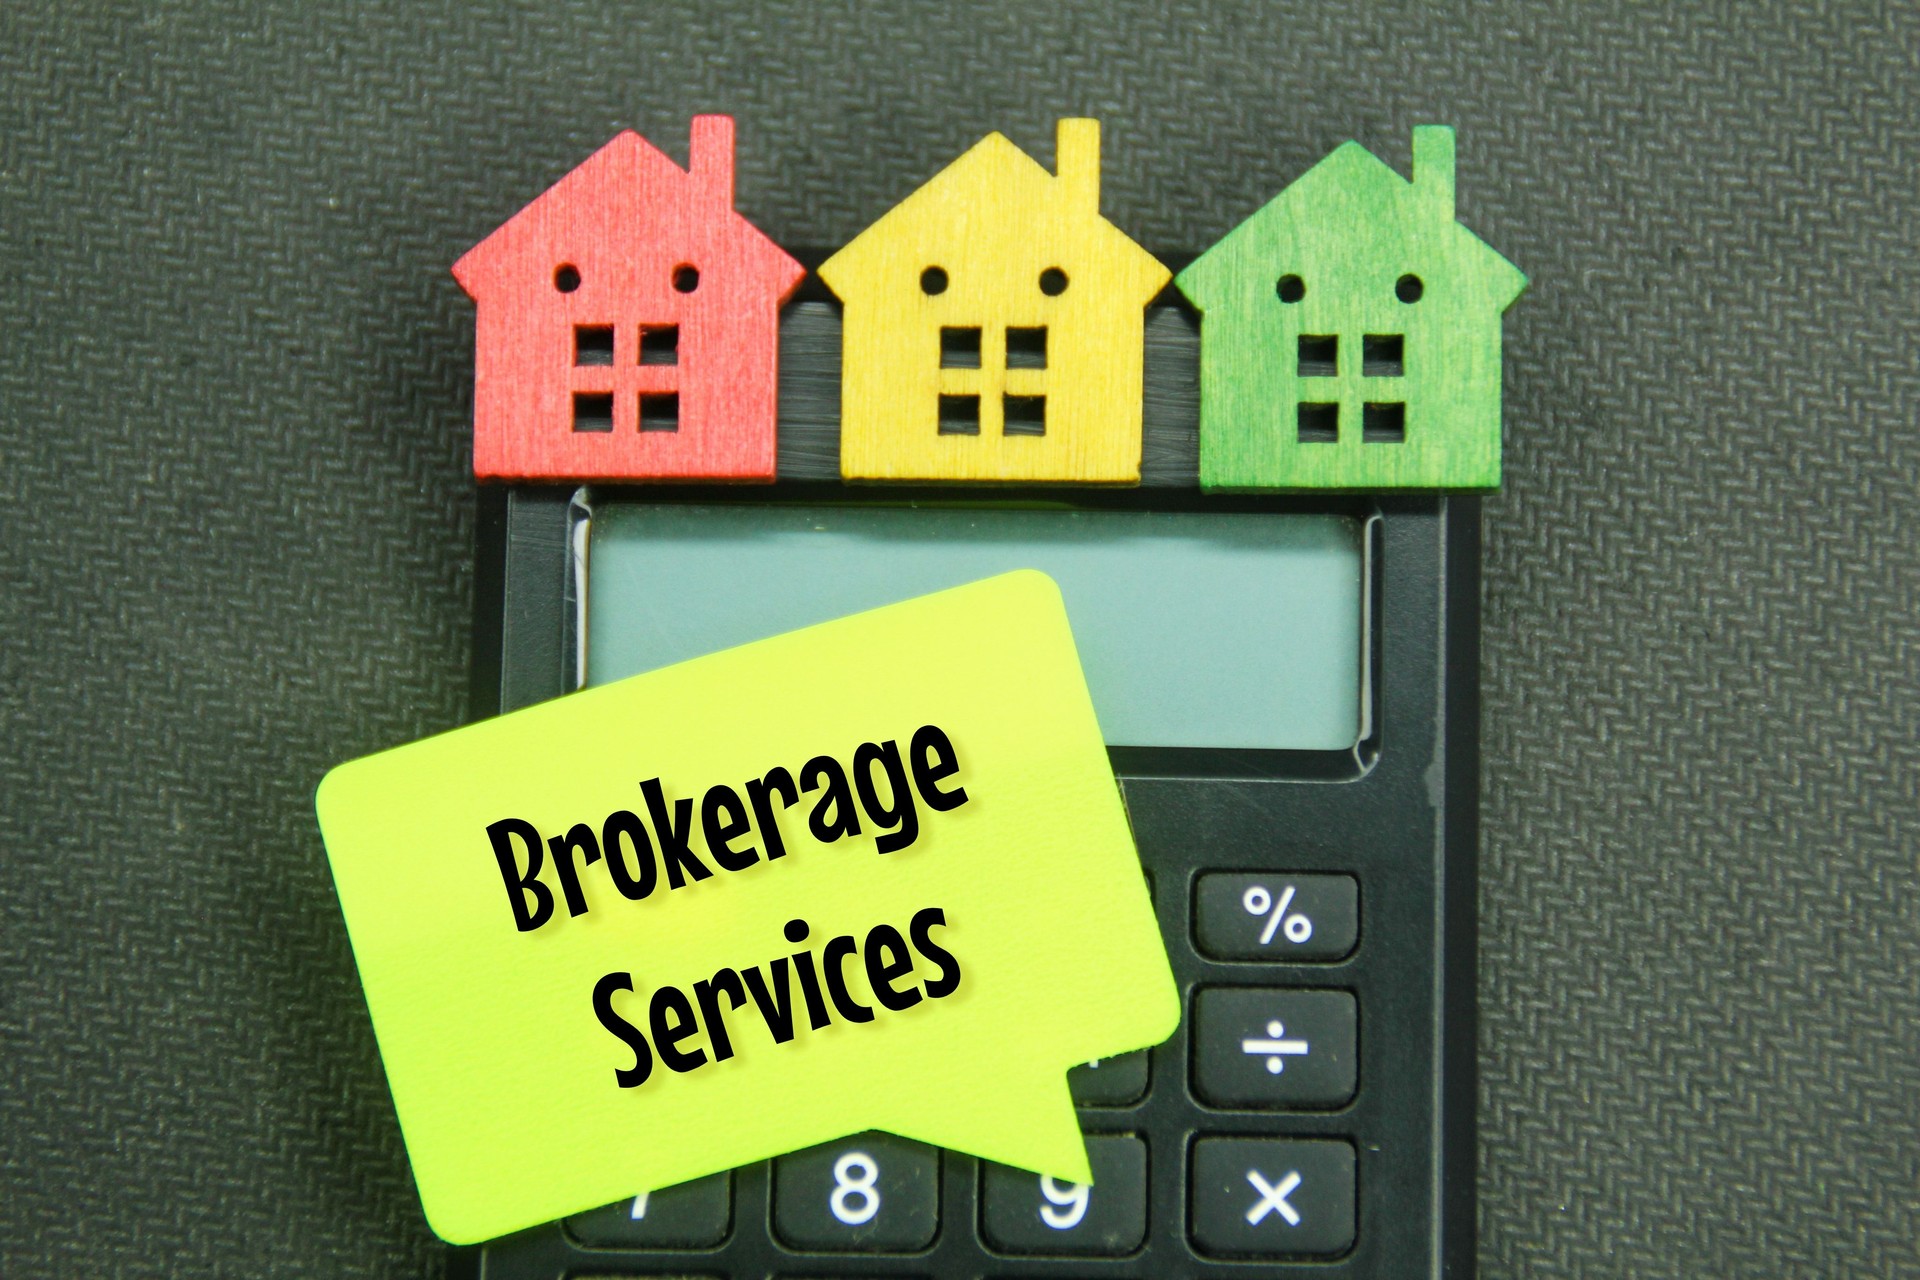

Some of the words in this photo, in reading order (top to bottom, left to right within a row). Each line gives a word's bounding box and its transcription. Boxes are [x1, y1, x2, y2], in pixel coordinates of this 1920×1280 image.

[486, 725, 969, 932] Brokerage
[1242, 885, 1313, 945] %
[592, 907, 961, 1089] Services
[829, 1152, 881, 1225] 8
[1039, 1174, 1091, 1229] 9
